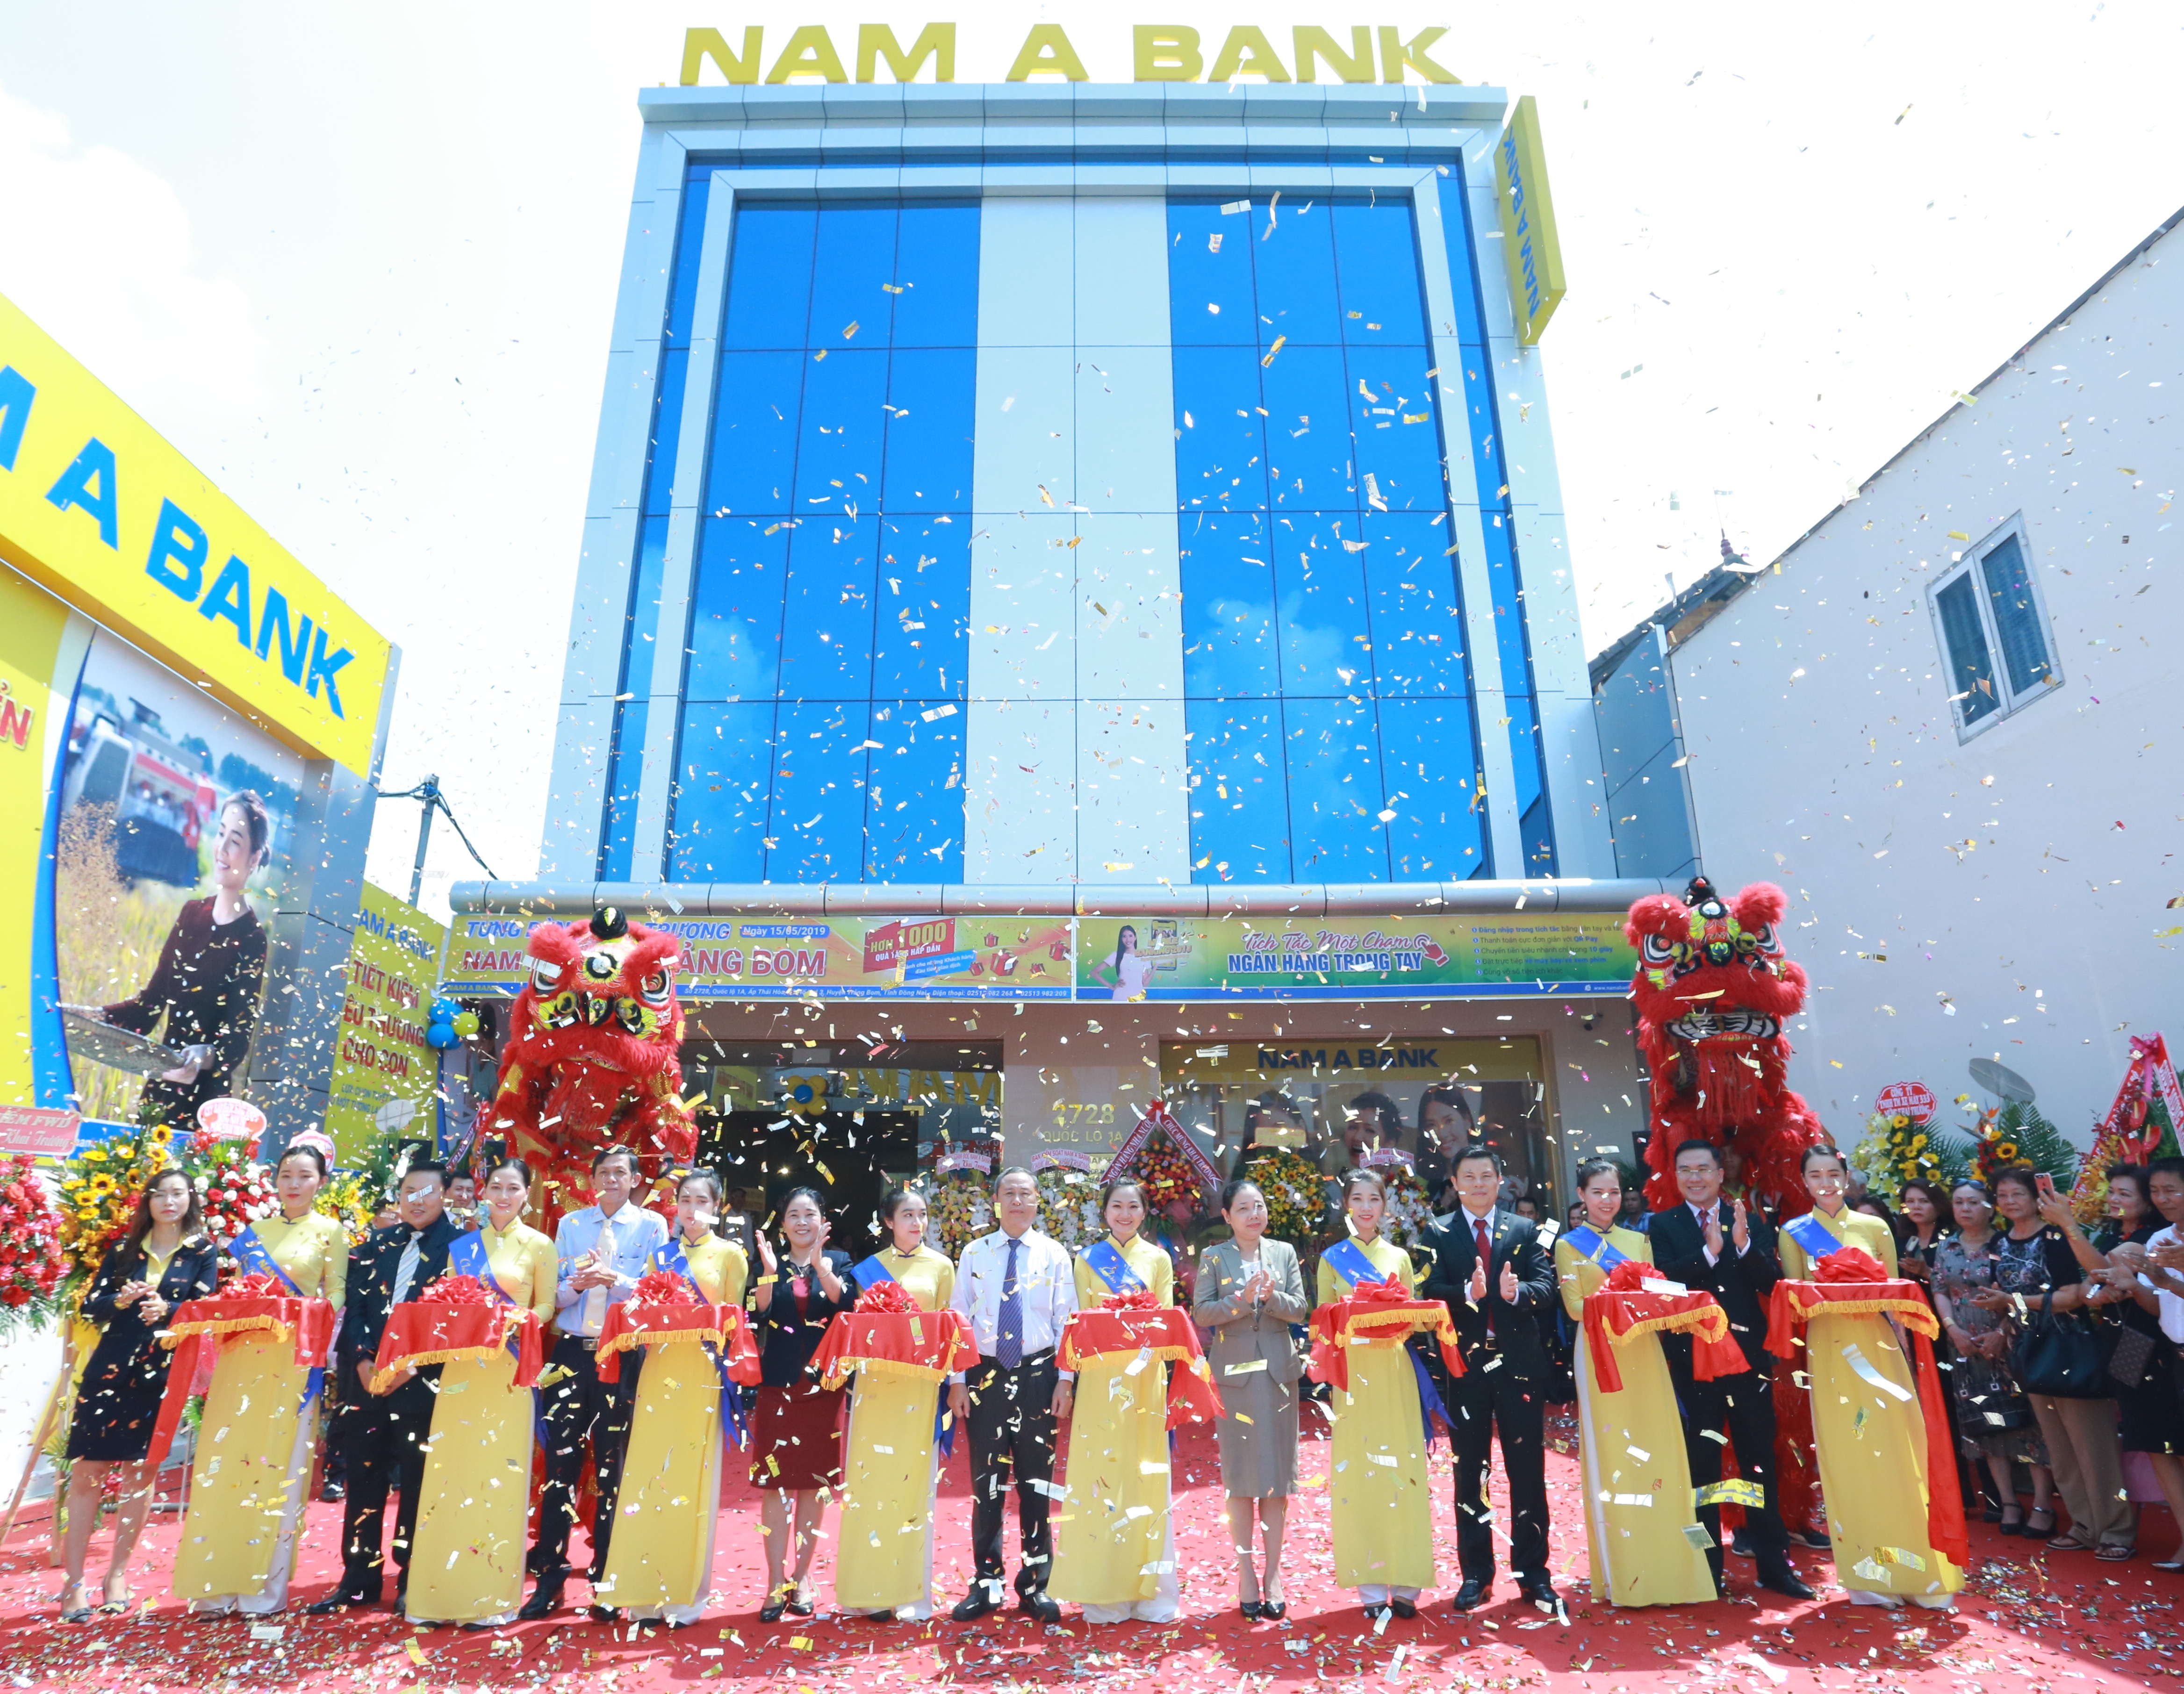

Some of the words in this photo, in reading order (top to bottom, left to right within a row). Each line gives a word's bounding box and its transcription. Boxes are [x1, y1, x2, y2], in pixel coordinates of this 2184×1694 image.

[680, 22, 956, 85] NAM
[1005, 23, 1090, 83] A
[1132, 25, 1464, 83] BANK
[1503, 125, 1524, 215] BANK
[1517, 208, 1528, 237] A
[1520, 235, 1540, 319] NAM
[44, 436, 119, 552] A
[145, 496, 355, 722] BANK
[358, 908, 385, 937] AM
[385, 923, 395, 944] A
[743, 925, 768, 938] Ngày
[770, 925, 826, 936] 15/05/2019
[870, 939, 893, 953] HƠN
[897, 922, 947, 948] 1000
[1242, 932, 1279, 950] Tích
[1281, 932, 1313, 950] Tắc
[1316, 930, 1358, 951] Một
[1362, 931, 1411, 950] Chạm
[462, 950, 522, 972] NAM
[676, 941, 743, 976] ẢNG
[750, 948, 826, 976] BOM
[876, 950, 889, 962] QUÀ
[1228, 951, 1278, 973] NGÂN
[1282, 949, 1331, 973] HÀNG
[1334, 951, 1392, 972] TRONG
[1395, 951, 1422, 971] TAY
[712, 987, 728, 995] Quốc
[344, 994, 364, 1026] ÊU
[343, 1037, 374, 1068] CHO
[1257, 1050, 1327, 1069] NAM
[1333, 1049, 1352, 1068] A
[1358, 1048, 1440, 1068] BANK
[31, 1115, 72, 1128] FWD
[1052, 1103, 1115, 1124] 2728
[1043, 1128, 1079, 1142] QUỐC
[1085, 1128, 1103, 1145] LỘ
[1108, 1131, 1124, 1143] 1A
